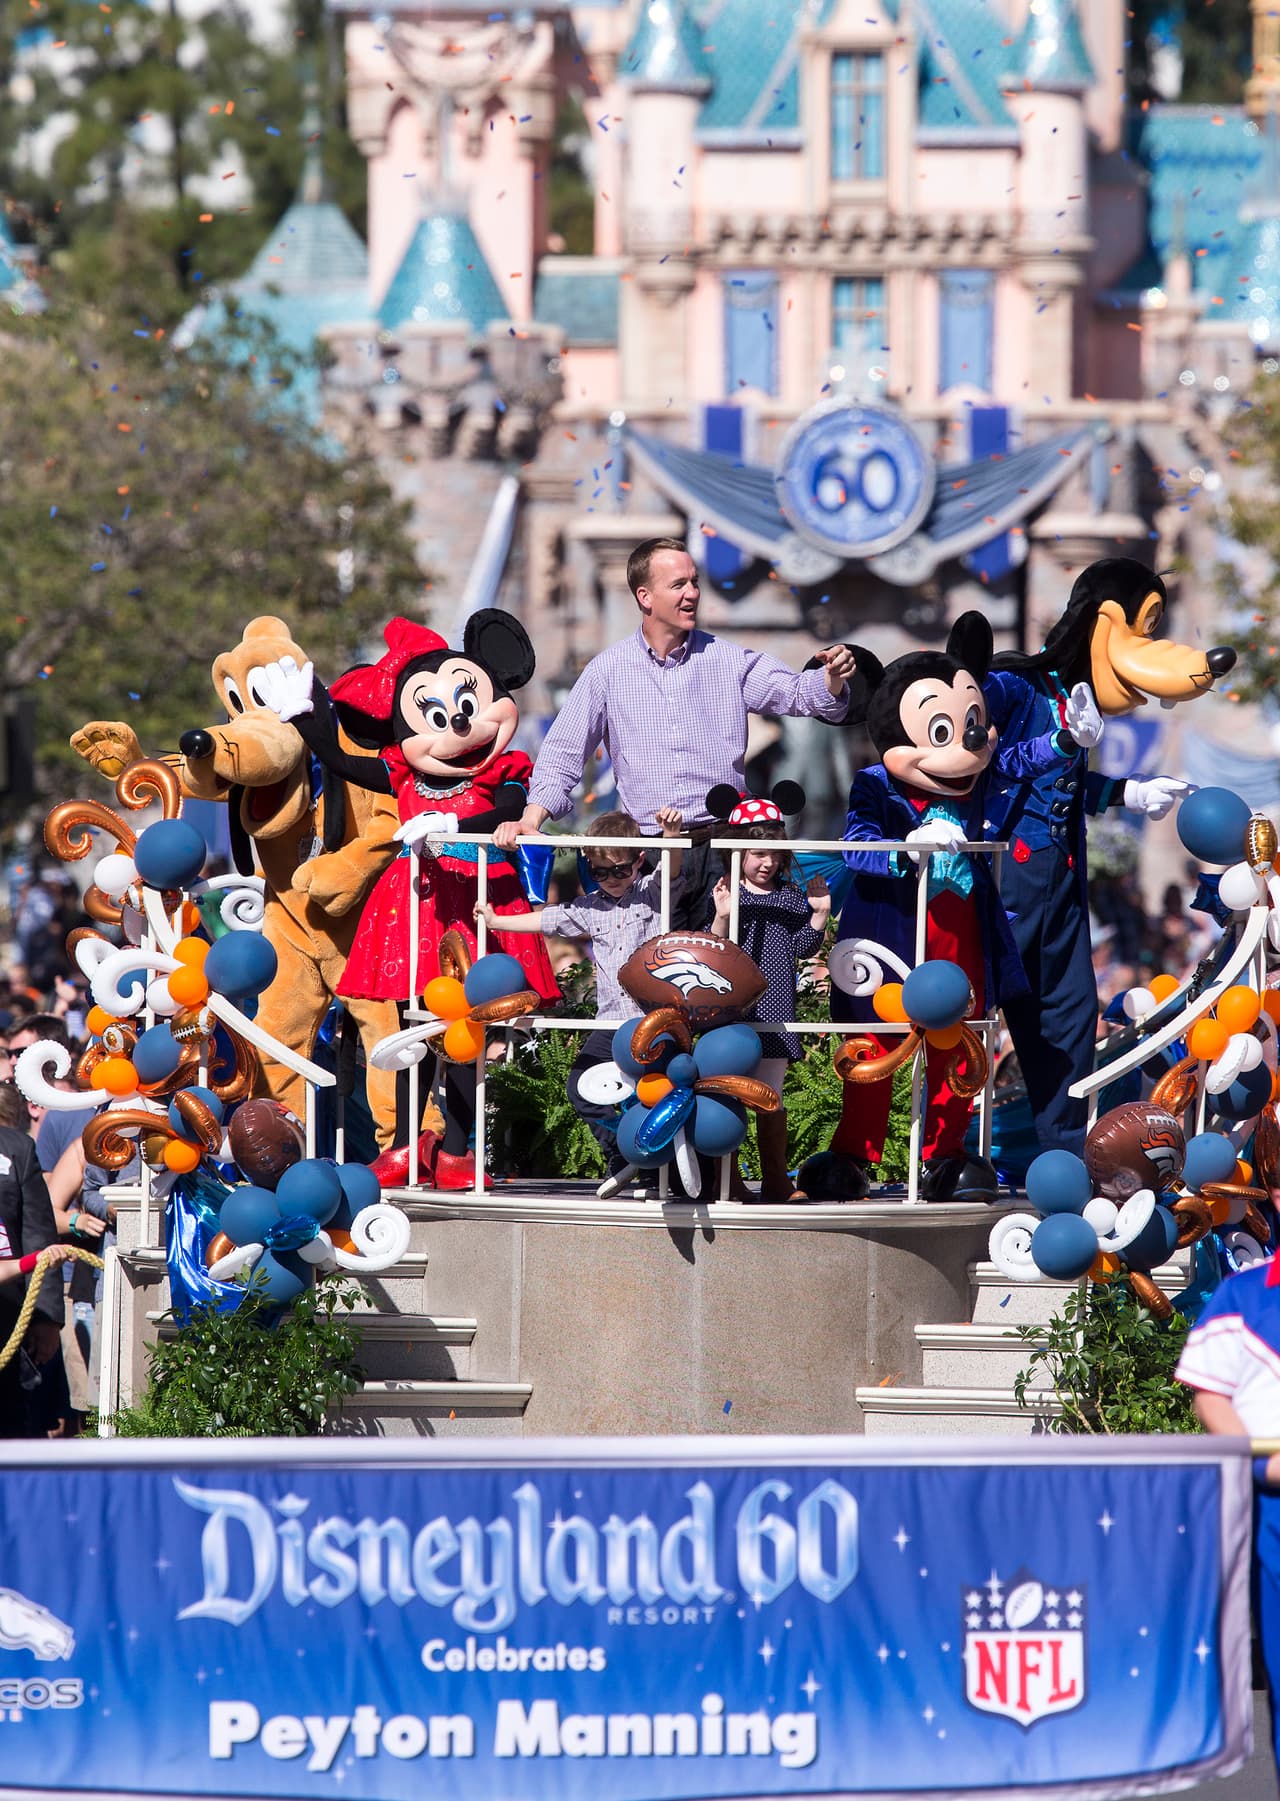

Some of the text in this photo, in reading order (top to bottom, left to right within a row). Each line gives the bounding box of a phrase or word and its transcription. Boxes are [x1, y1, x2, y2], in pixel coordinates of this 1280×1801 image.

[811, 447, 898, 514] 60
[172, 1475, 859, 1634] Disneyland 60
[607, 1606, 715, 1626] RESORT
[421, 1636, 606, 1672] Celebrates
[974, 1640, 1076, 1712] NFL
[209, 1693, 817, 1772] Peyton Manning
